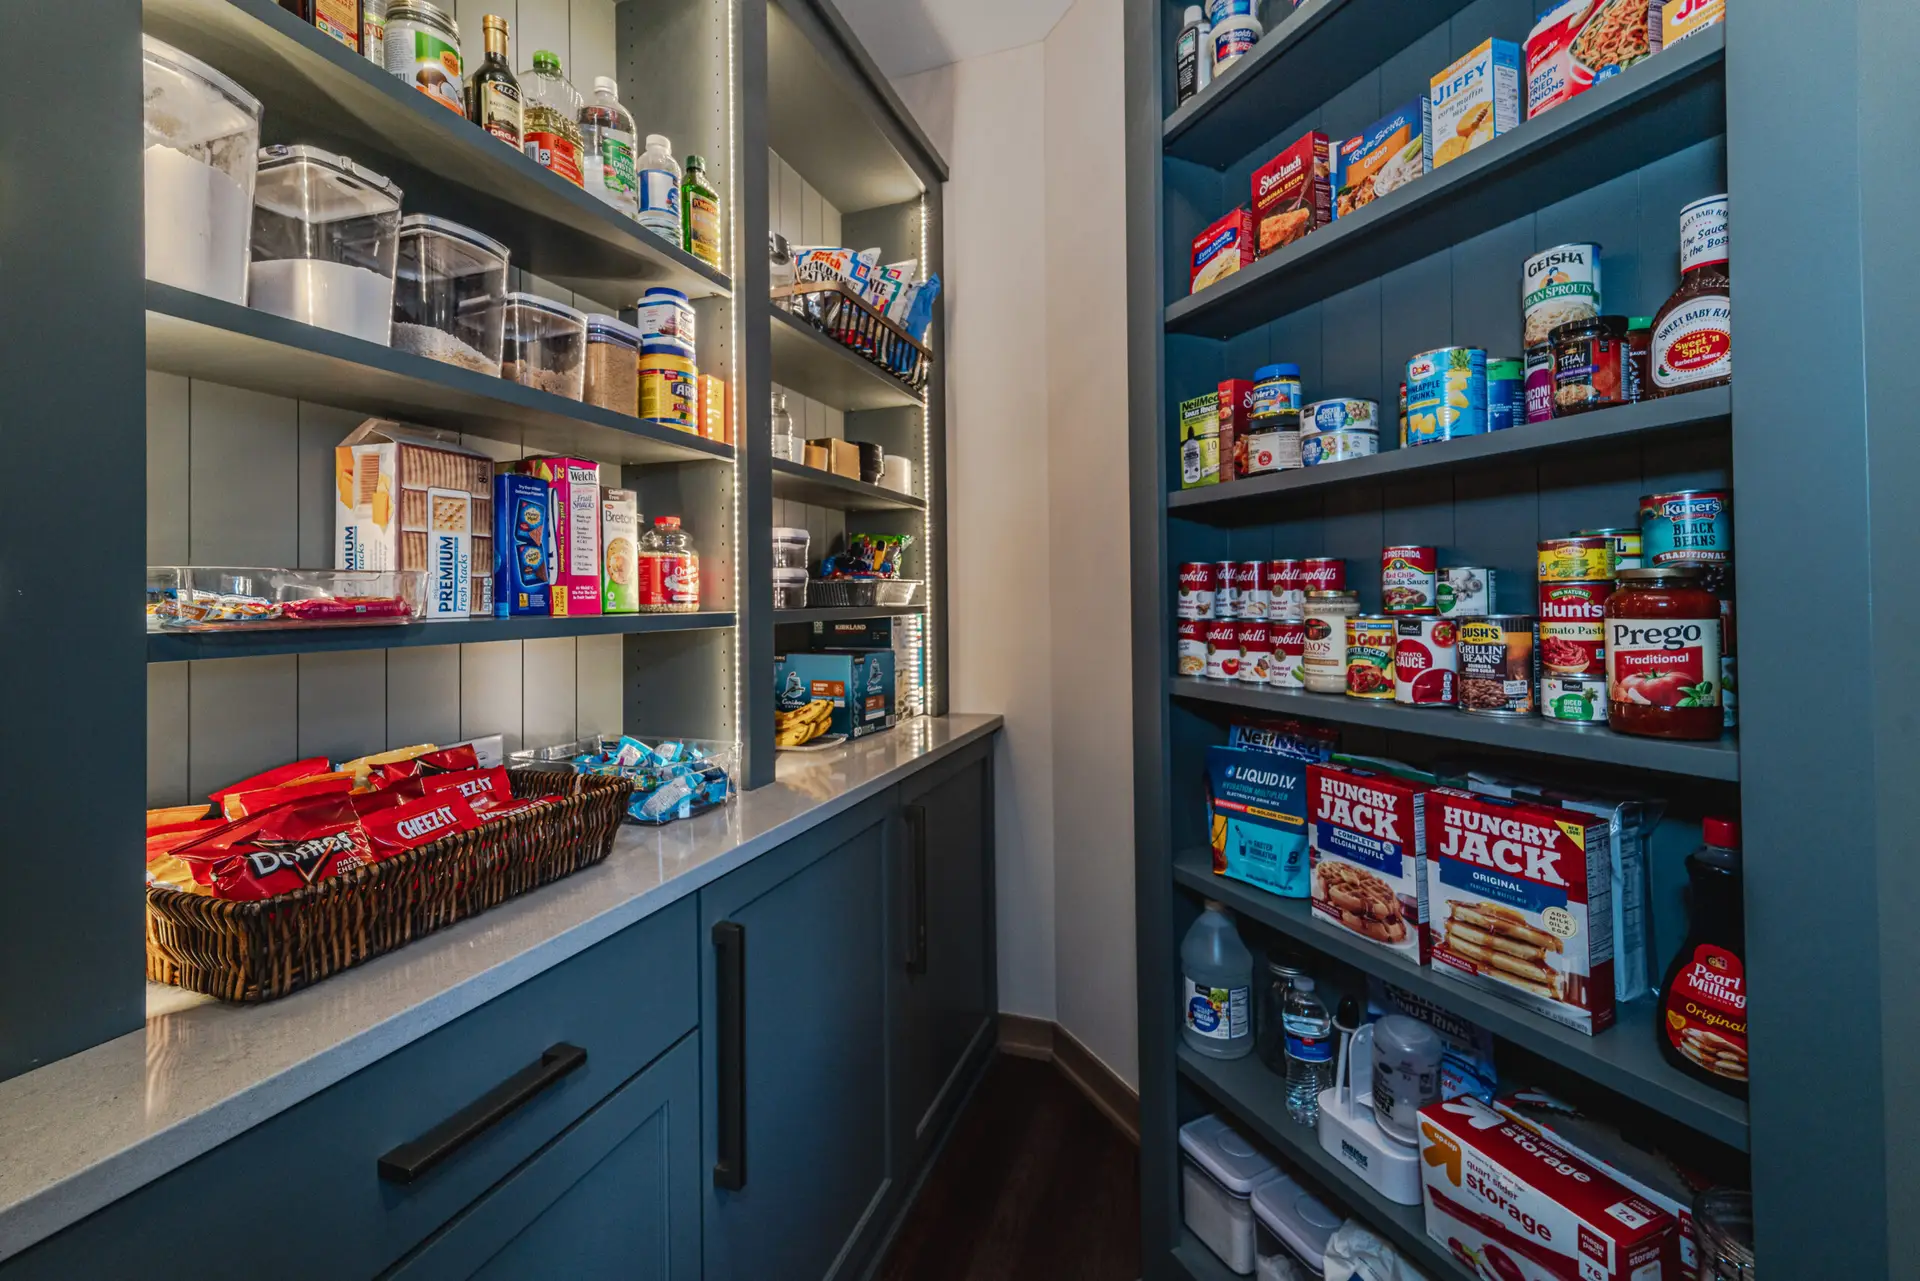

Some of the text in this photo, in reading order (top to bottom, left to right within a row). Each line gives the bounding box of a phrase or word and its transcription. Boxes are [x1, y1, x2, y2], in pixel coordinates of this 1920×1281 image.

[1433, 60, 1487, 106] JIFFY
[1529, 64, 1558, 89] CRISPY
[1529, 77, 1553, 98] FRIED
[1529, 79, 1565, 107] ONIONS
[1364, 146, 1388, 169] Onion
[1689, 244, 1704, 257] the
[1528, 252, 1584, 278] GEISHA
[1546, 283, 1592, 297] SPROUTS
[1659, 308, 1712, 341] SWEET BABY
[1675, 336, 1707, 352] Sweet
[1681, 345, 1712, 358] Spicy
[1530, 397, 1550, 412] MILK
[556, 467, 564, 479] 22
[570, 471, 598, 482] Welch's
[605, 510, 636, 524] Breton
[1673, 522, 1715, 535] BLACK
[1674, 535, 1716, 548] BEANS
[1660, 550, 1726, 560] TRADITIONAL
[439, 536, 453, 612] PREMIUM
[458, 554, 468, 612] Fresh Stacks
[1358, 633, 1396, 646] GOLD
[1461, 627, 1500, 639] BUSH'S
[1542, 625, 1575, 636] Tomato
[1613, 623, 1702, 650] Prego
[1458, 642, 1506, 657] GRILLIN'
[1463, 653, 1502, 664] BEANS
[1625, 652, 1689, 665] Traditional
[1396, 657, 1426, 669] SAUCE
[1235, 766, 1281, 787] LIQUID
[1320, 776, 1397, 811] HUNGRY
[1317, 794, 1404, 843] JACK
[1443, 805, 1561, 849] HUNGRY
[1330, 836, 1385, 860] BELGIAN WAFFLE
[1337, 830, 1376, 848] COMPLETE
[249, 832, 353, 876] Doritos
[1287, 851, 1299, 865] 8
[1440, 825, 1565, 887] JACK
[1472, 871, 1523, 893] ORIGINAL
[1550, 910, 1568, 920] ADD
[1551, 926, 1568, 936] EGG
[1694, 963, 1741, 990] Pearl
[1686, 973, 1746, 1009] Milling
[1686, 1002, 1747, 1033] Original
[1500, 1126, 1592, 1183] storage
[1539, 1139, 1569, 1159] slider
[1466, 1160, 1491, 1182] quart
[1492, 1176, 1519, 1201] slider
[1466, 1172, 1553, 1242] storage
[1617, 1208, 1637, 1223] 76
[1582, 1242, 1604, 1259] pack
[1585, 1262, 1603, 1280] 76
